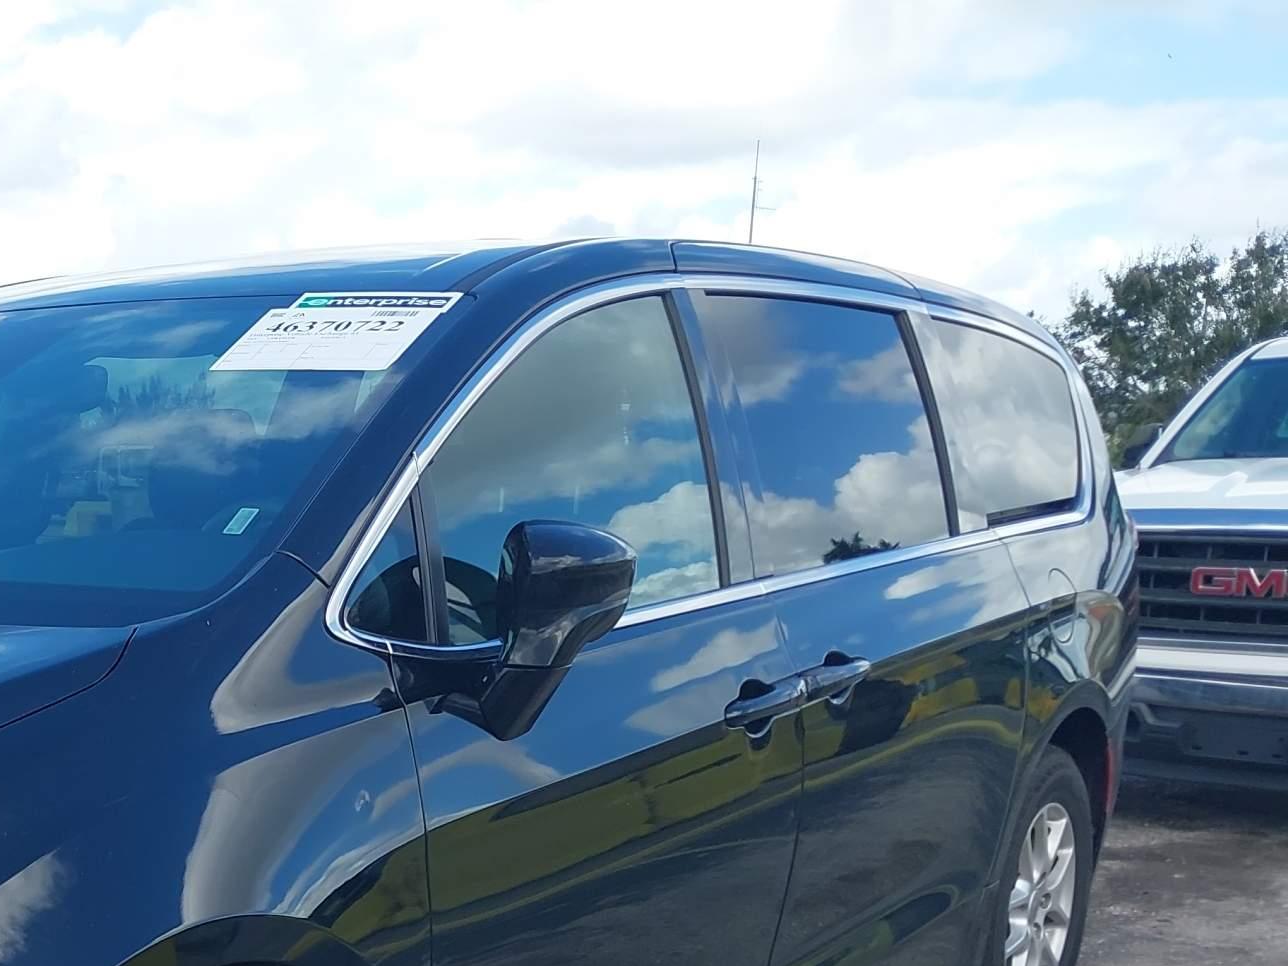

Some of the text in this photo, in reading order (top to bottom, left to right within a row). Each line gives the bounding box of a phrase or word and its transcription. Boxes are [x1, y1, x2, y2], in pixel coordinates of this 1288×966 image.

[307, 296, 448, 308] enterprise
[265, 319, 406, 333] 46370722
[1190, 566, 1288, 598] GM
